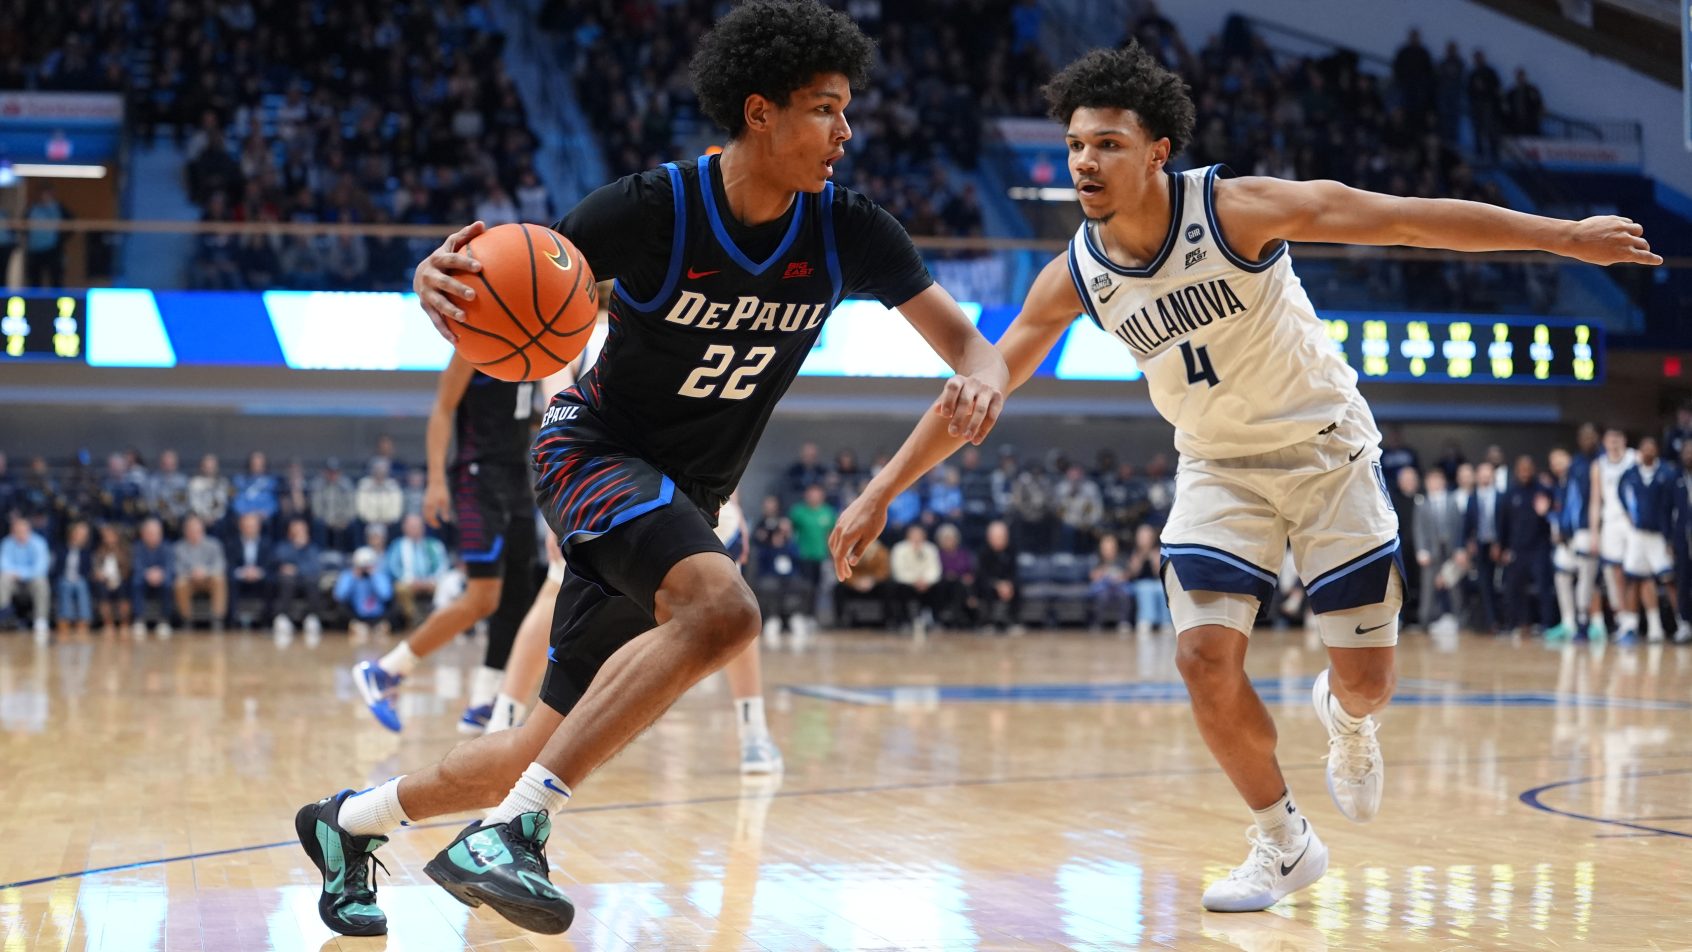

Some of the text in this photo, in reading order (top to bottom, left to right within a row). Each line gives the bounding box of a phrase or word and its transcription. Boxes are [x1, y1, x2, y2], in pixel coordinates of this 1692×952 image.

[1185, 247, 1201, 260] BIG
[1185, 250, 1207, 266] EAST
[784, 268, 814, 276] EAST
[788, 261, 808, 269] BIG
[1115, 279, 1247, 354] VILLANOVA
[677, 344, 776, 400] 22
[1177, 340, 1220, 388] 4
[541, 405, 580, 427] EPAUL
